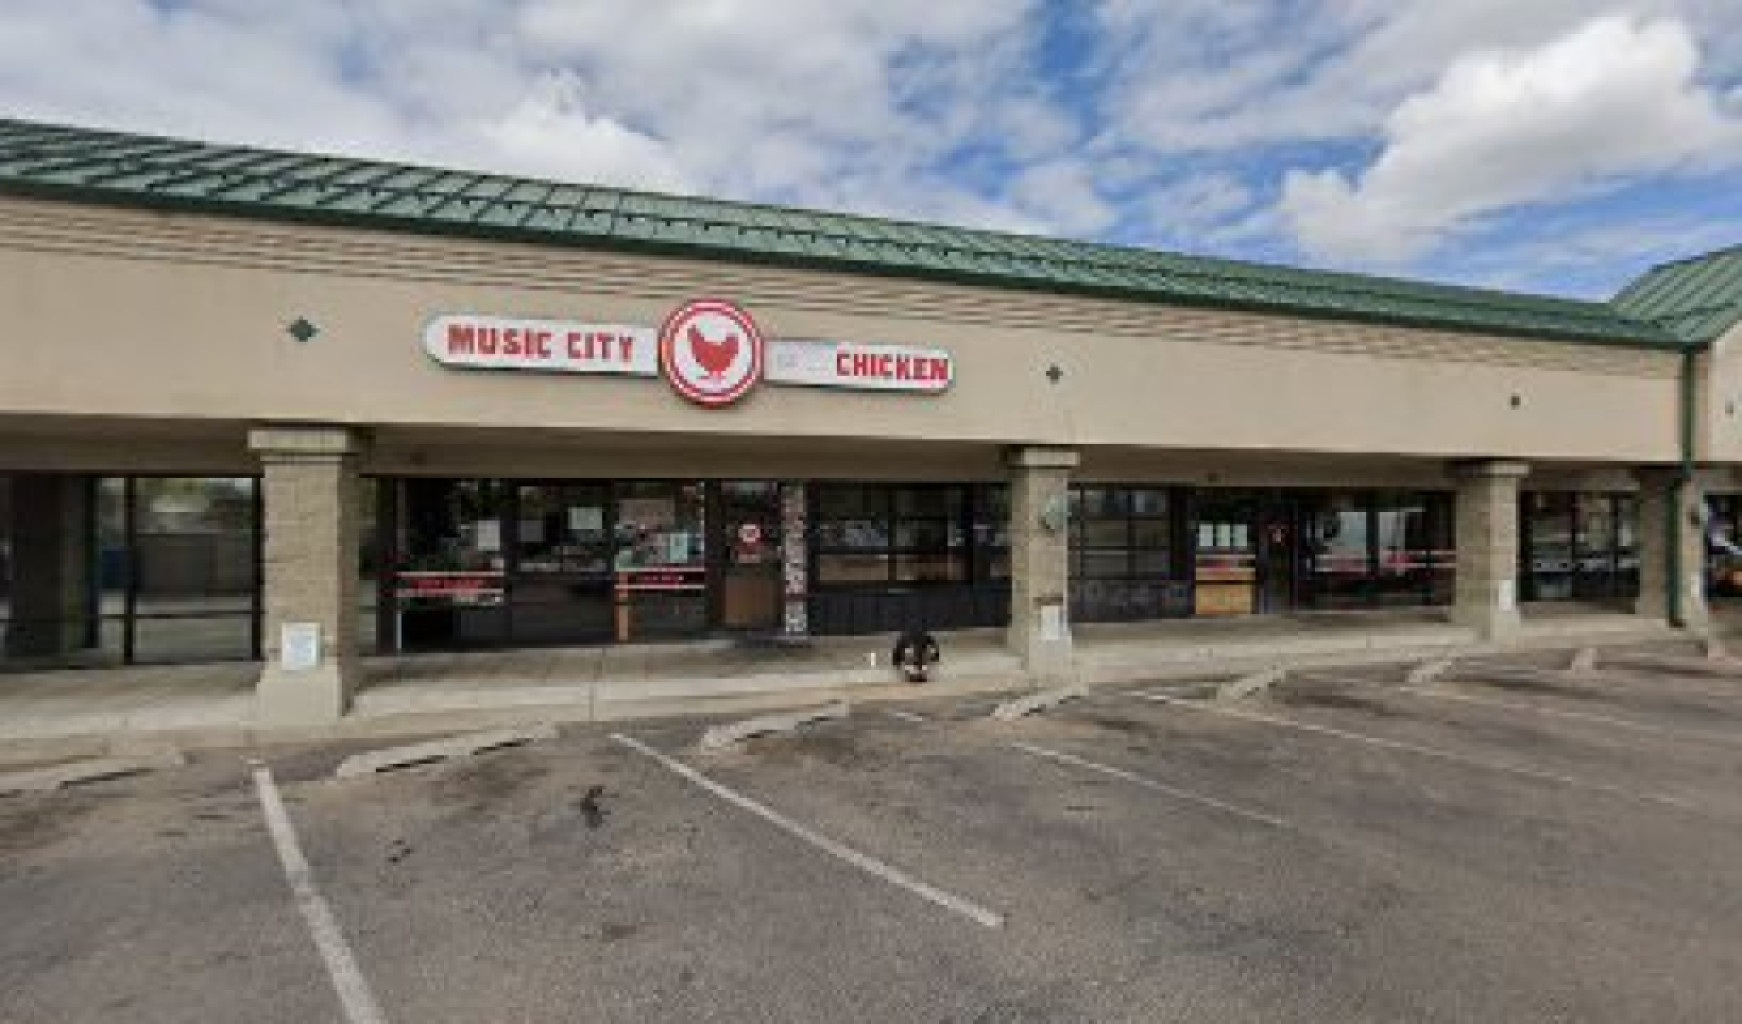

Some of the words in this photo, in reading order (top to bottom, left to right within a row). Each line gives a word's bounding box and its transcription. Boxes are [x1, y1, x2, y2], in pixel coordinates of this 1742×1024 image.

[448, 324, 552, 359] MUSIC
[567, 332, 634, 363] CITY
[836, 353, 949, 381] CHICKEN
